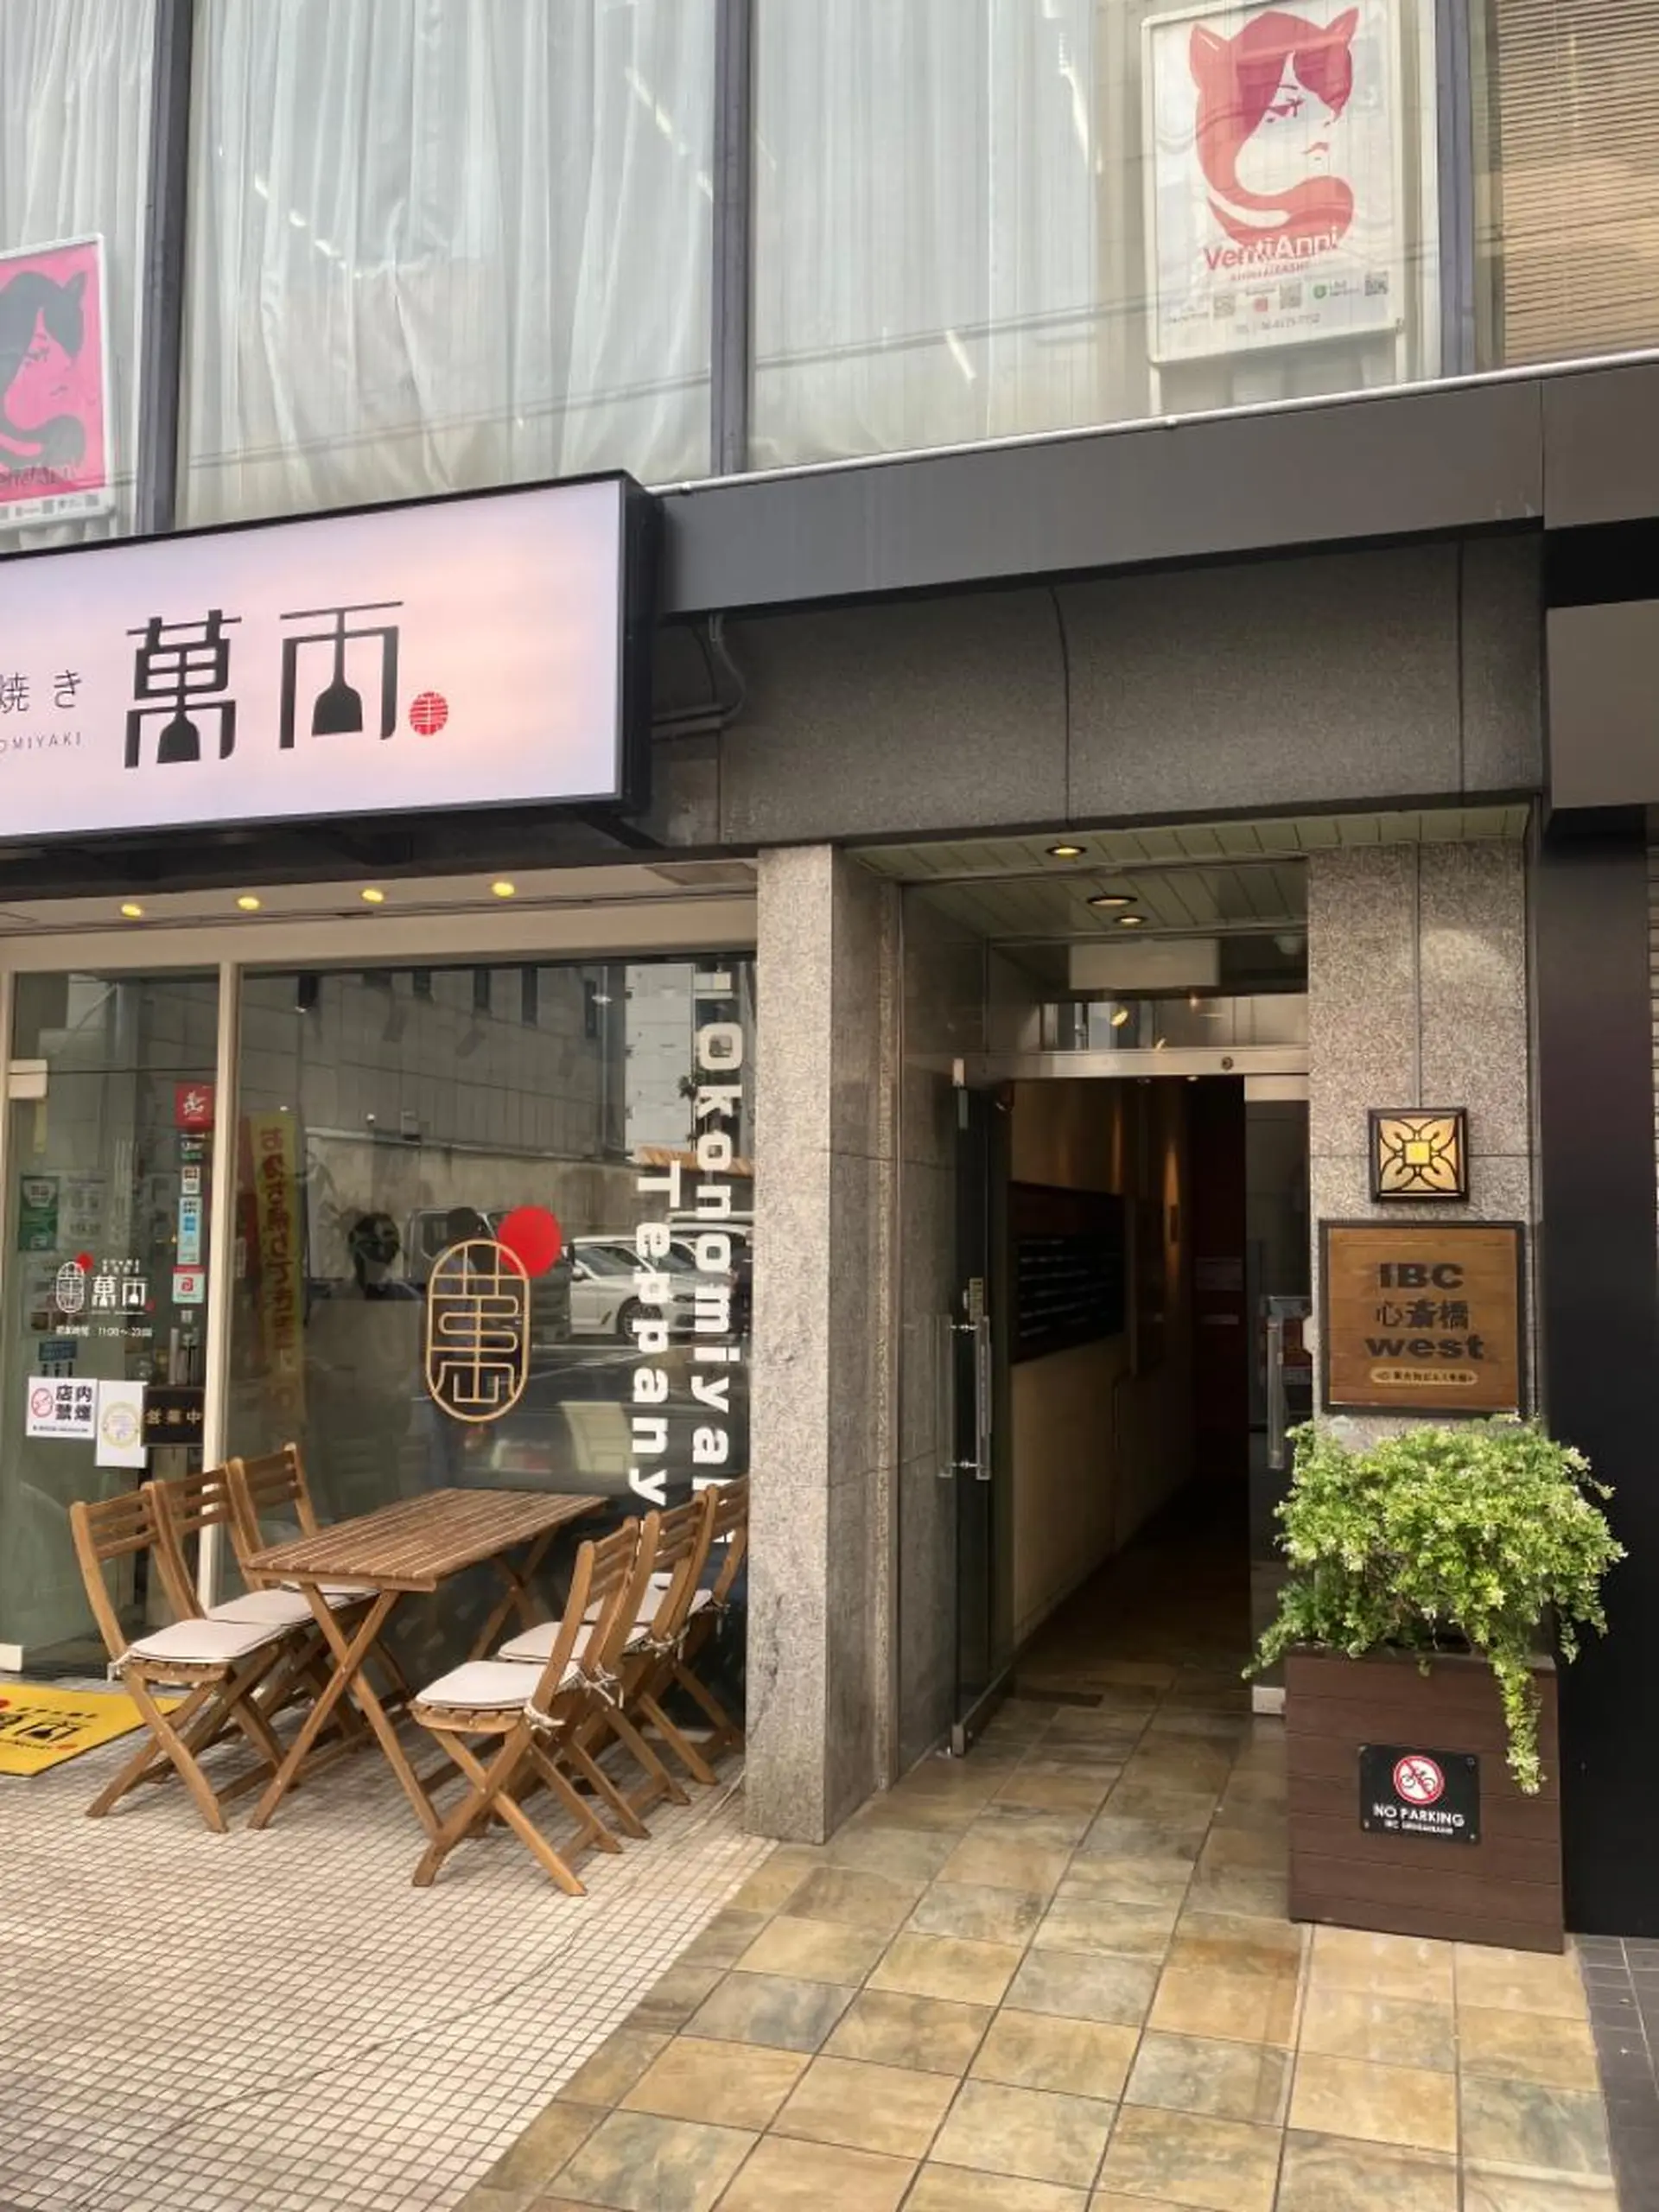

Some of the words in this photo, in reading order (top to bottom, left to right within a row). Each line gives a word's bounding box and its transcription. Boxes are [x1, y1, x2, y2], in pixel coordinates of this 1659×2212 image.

[1379, 1262, 1464, 1290] IBC
[629, 1160, 681, 1505] Teppany
[1364, 1334, 1484, 1360] west
[55, 1384, 92, 1402] 店内
[1373, 1803, 1397, 1818] NO
[1400, 1808, 1465, 1827] PARKING
